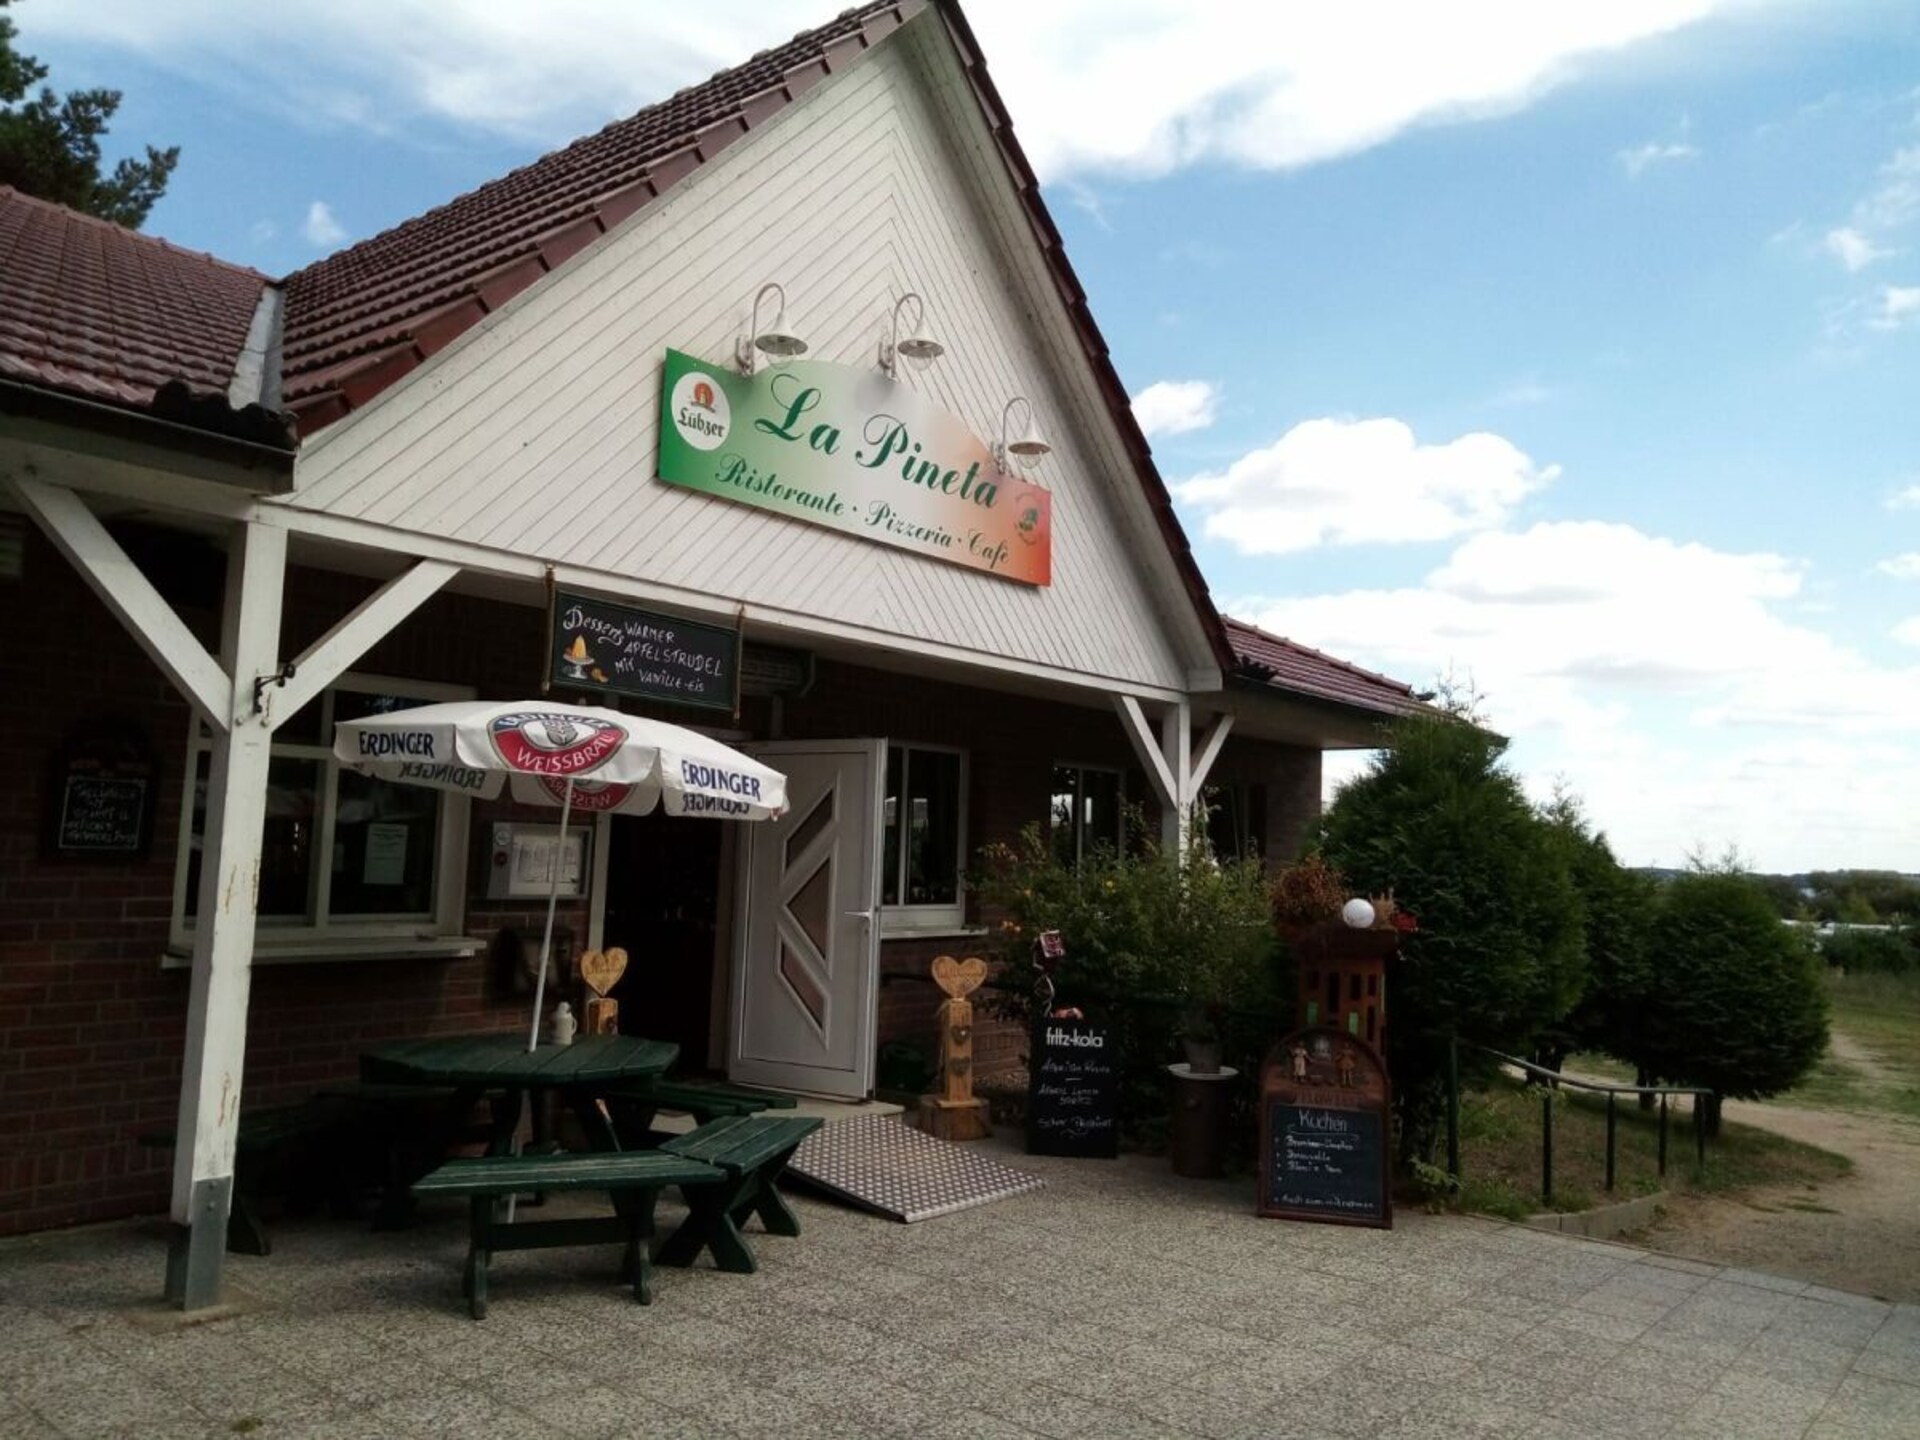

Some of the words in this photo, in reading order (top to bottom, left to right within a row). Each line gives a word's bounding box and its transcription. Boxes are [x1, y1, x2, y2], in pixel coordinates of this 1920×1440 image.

[677, 407, 725, 438] Lübzer
[754, 373, 841, 455] La
[855, 414, 998, 508] Pineta
[715, 453, 845, 515] Ristorante
[864, 500, 952, 548] Pizzeria
[562, 603, 625, 646] Desserts
[624, 620, 675, 644] WARMER
[358, 730, 436, 759] ERDINGER
[681, 759, 761, 803] ERDINGER
[1045, 1026, 1104, 1048] fritz-kola
[1298, 1108, 1348, 1132] Kuchen
